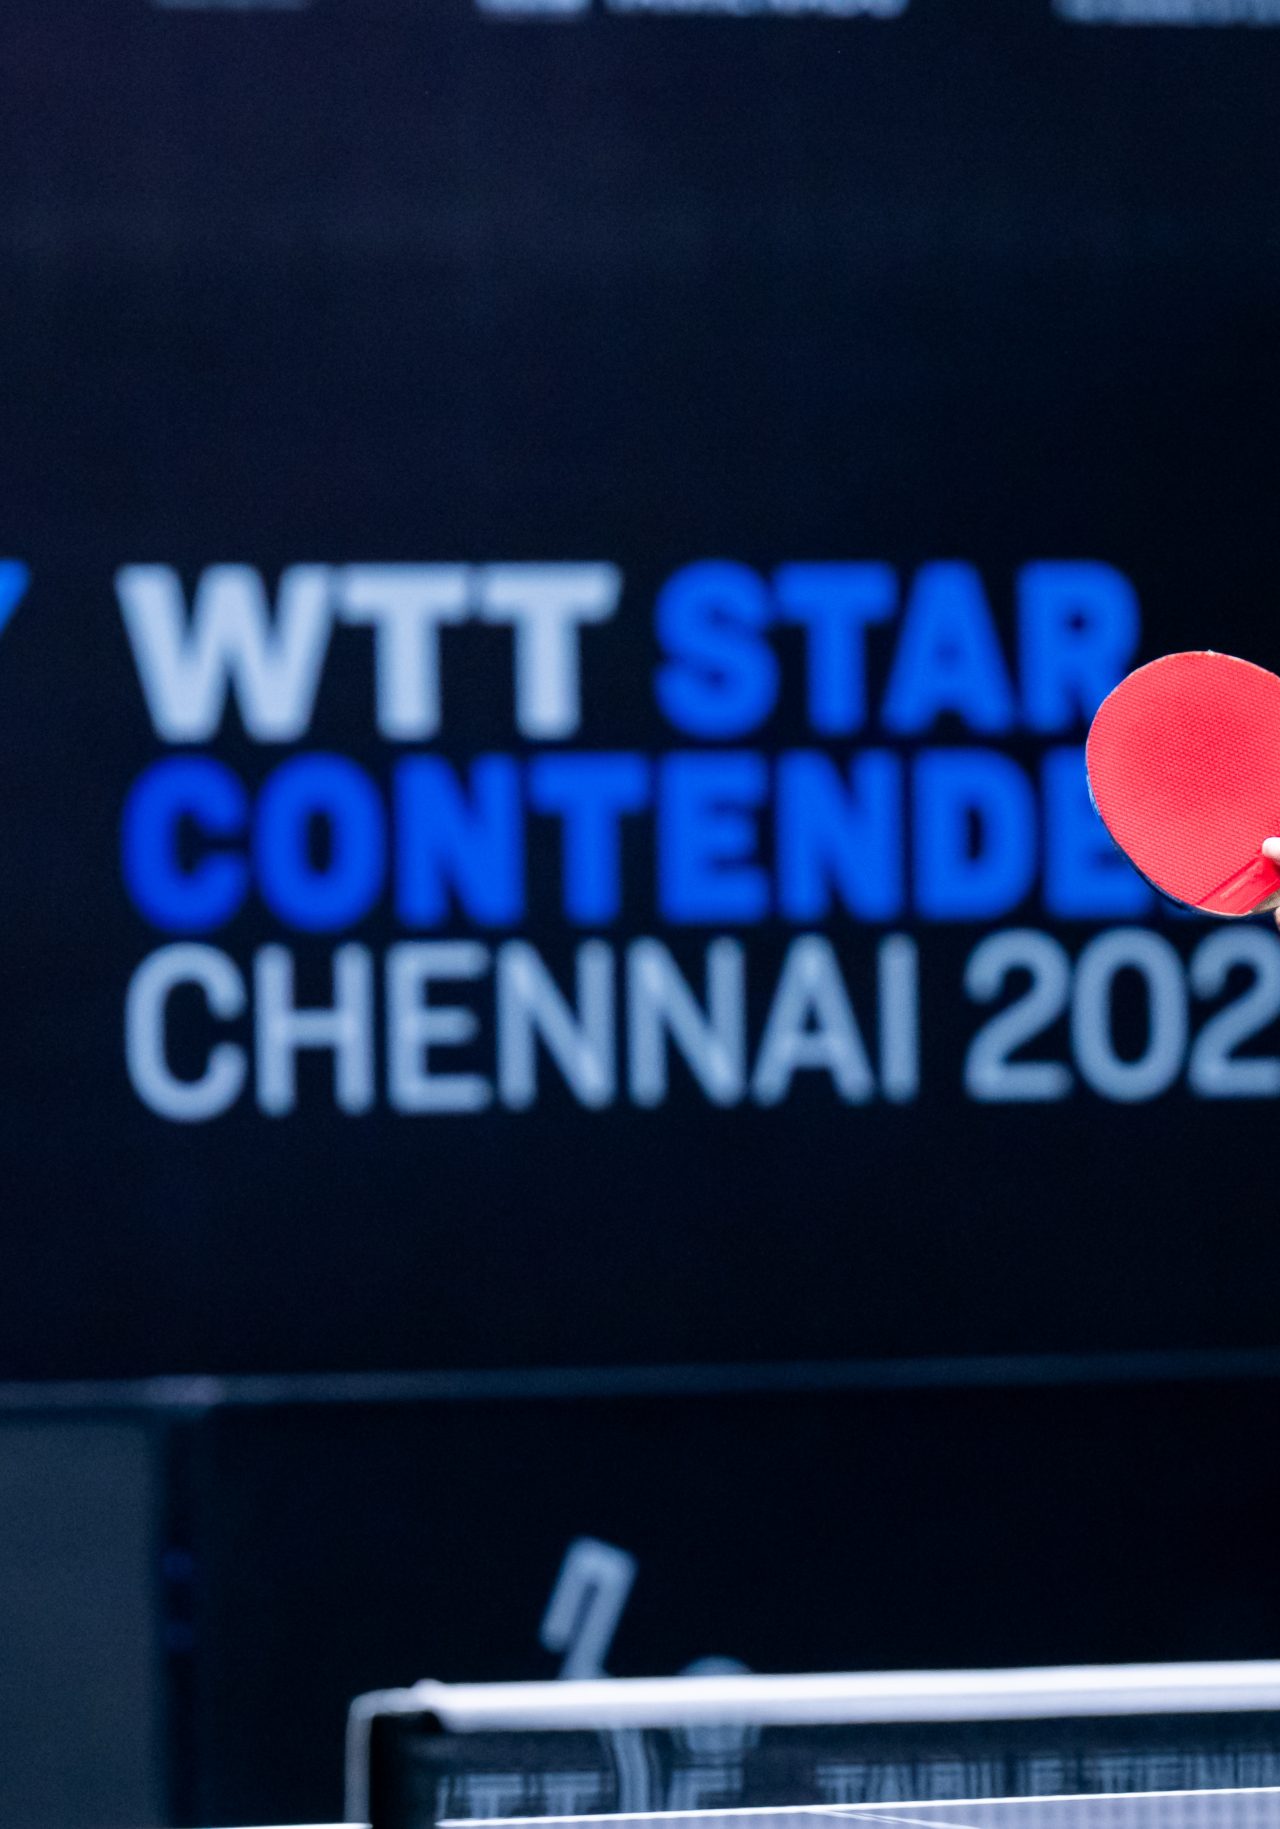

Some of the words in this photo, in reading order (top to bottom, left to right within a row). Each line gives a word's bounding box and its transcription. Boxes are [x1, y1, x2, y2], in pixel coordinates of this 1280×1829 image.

[116, 562, 622, 744] WTT
[654, 559, 1139, 740] STAR
[120, 750, 1215, 934] CONTENDE
[123, 932, 922, 1123] CHENNAI
